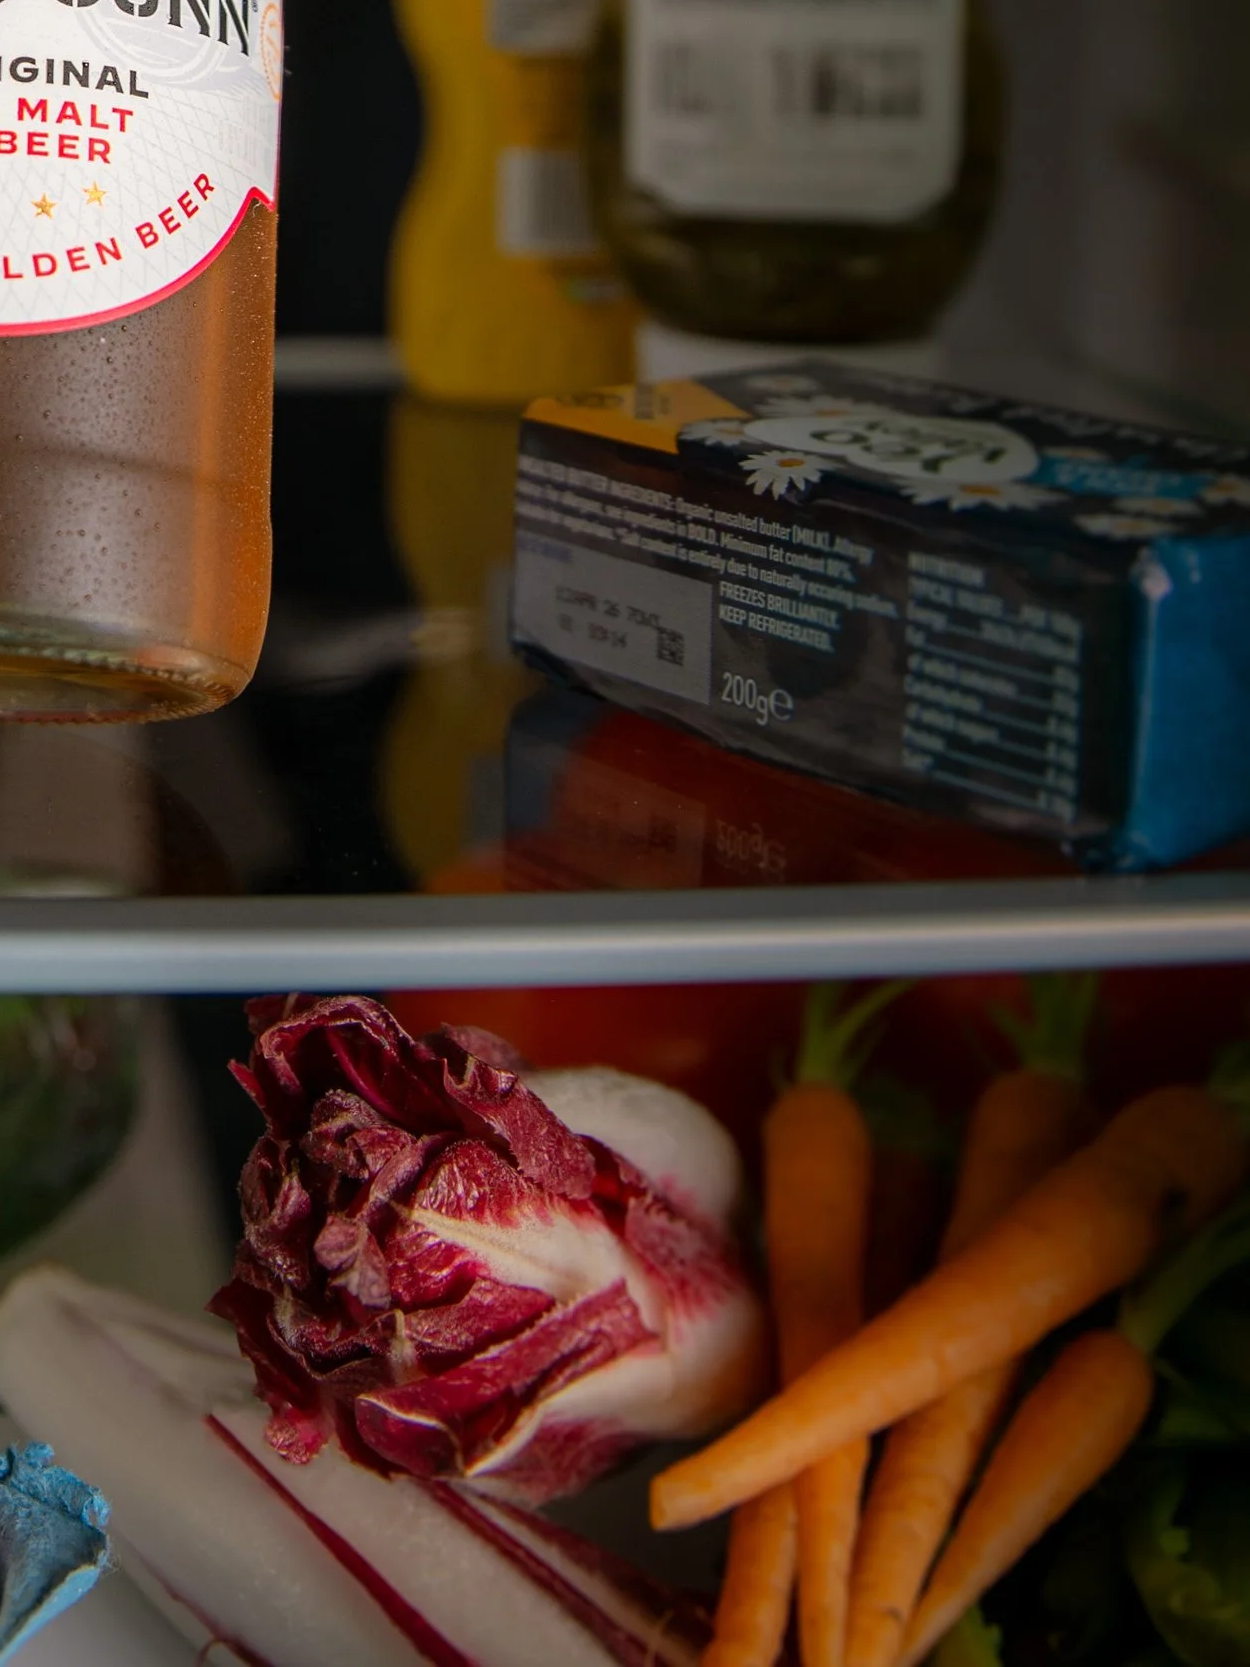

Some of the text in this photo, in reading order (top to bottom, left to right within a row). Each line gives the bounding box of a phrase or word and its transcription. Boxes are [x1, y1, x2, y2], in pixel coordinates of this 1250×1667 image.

[16, 97, 135, 134] MALT
[135, 172, 216, 249] BEER
[759, 517, 791, 540] butter
[768, 542, 783, 564] fat
[726, 557, 746, 577] due
[747, 562, 758, 581] to
[759, 566, 806, 596] naturally
[718, 579, 766, 609] FREEZES
[718, 603, 748, 626] KEEP
